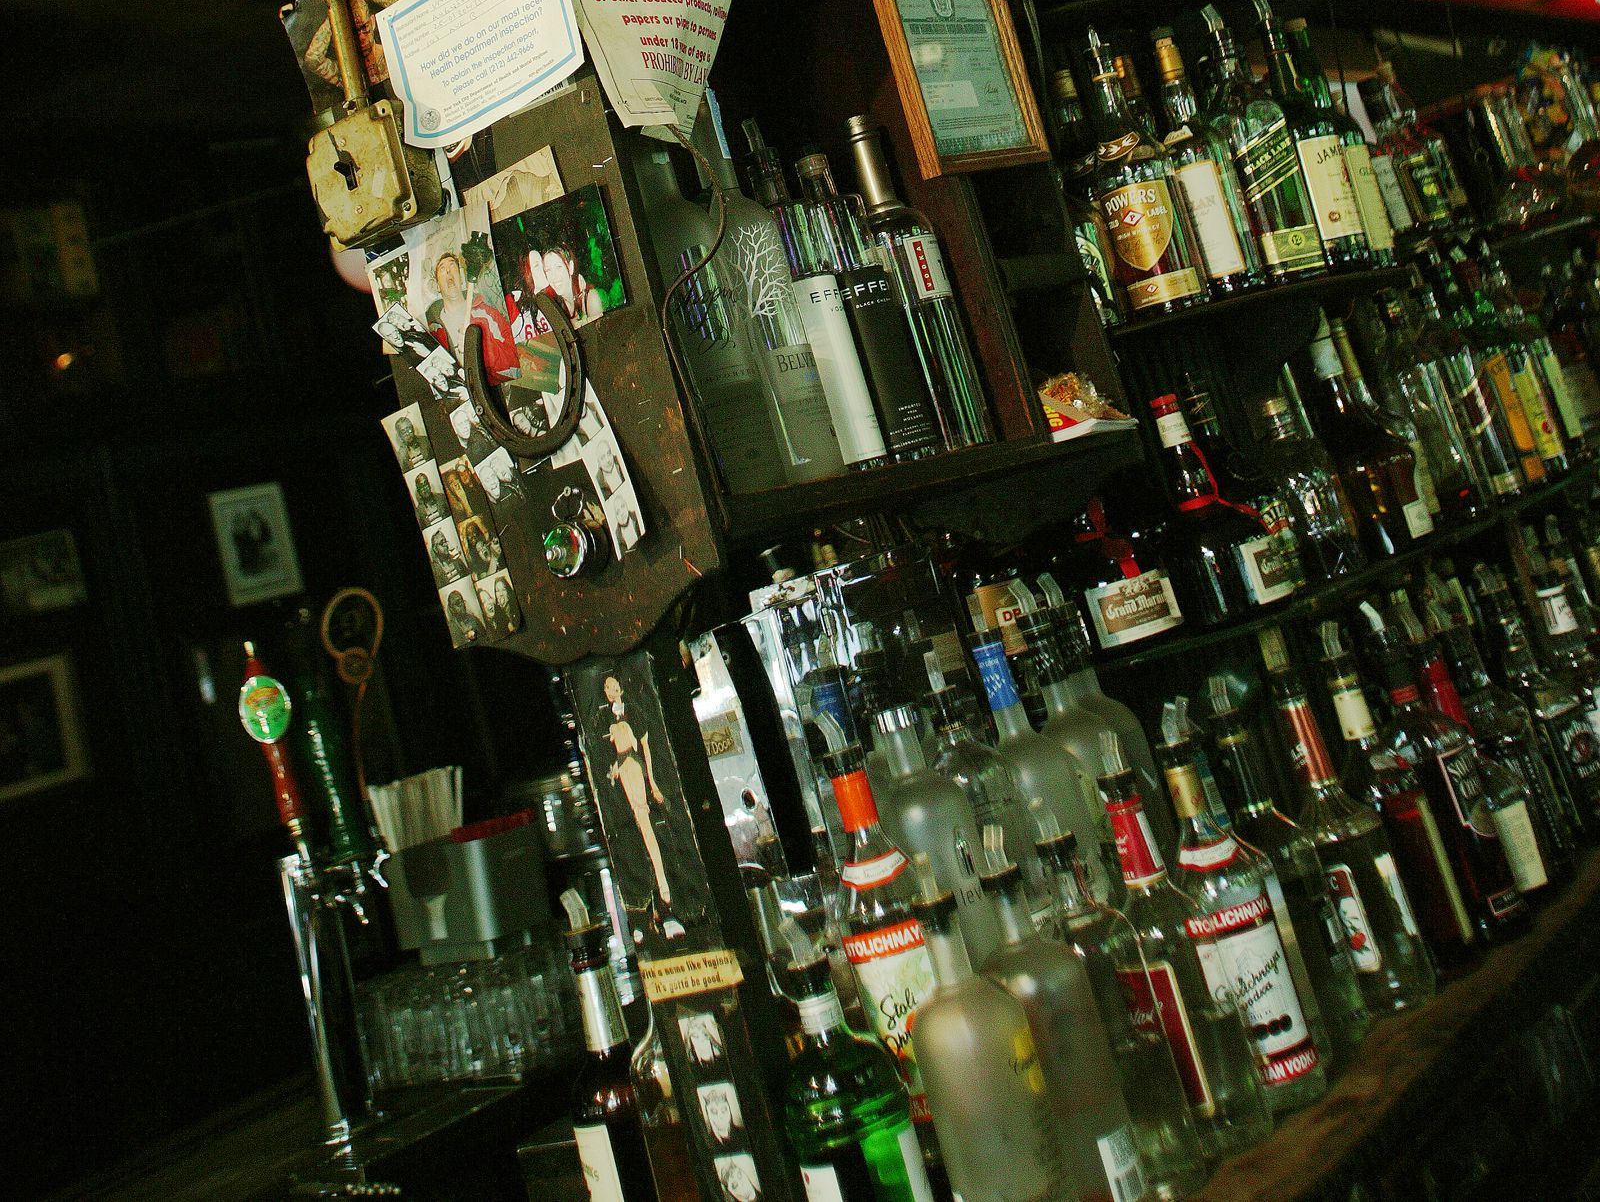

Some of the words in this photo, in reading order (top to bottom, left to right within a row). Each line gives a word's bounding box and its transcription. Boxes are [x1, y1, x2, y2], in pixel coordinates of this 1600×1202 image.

[420, 58, 437, 72] How
[437, 48, 450, 63] did
[451, 42, 463, 54] we
[464, 32, 475, 47] do
[477, 29, 488, 39] on
[488, 21, 500, 34] our
[500, 7, 521, 28] most
[622, 14, 660, 25] papers
[690, 22, 697, 33] to
[698, 25, 717, 42] persons
[430, 60, 454, 79] Health
[454, 34, 499, 67] Department
[499, 7, 544, 43] inspection?
[450, 65, 471, 84] obtain
[472, 61, 483, 72] the
[483, 40, 516, 69] inspection
[516, 28, 539, 49] report,
[640, 36, 669, 48] under
[670, 36, 679, 50] 18
[688, 44, 695, 57] of
[696, 47, 706, 62] age
[453, 76, 475, 95] please
[475, 69, 489, 82] call
[489, 59, 506, 77] (212)
[506, 42, 534, 65] 442-9666
[683, 62, 694, 81] BY
[1244, 153, 1271, 176] BLACK
[1105, 188, 1156, 216] POWERS
[915, 243, 933, 289] VODKA
[856, 300, 876, 309] BLACK
[898, 402, 921, 411] IMPORTED
[1042, 405, 1064, 427] BIG
[1105, 599, 1138, 621] Grand
[1188, 895, 1271, 937] STOLICHNAYA
[642, 967, 656, 979] With
[664, 964, 685, 975] name
[686, 960, 701, 971] like
[704, 956, 732, 969] Vagina,
[669, 979, 689, 993] gotta
[691, 976, 700, 987] be
[702, 973, 724, 987] good.
[879, 988, 919, 1031] Stoli
[1285, 1049, 1317, 1077] VODKA
